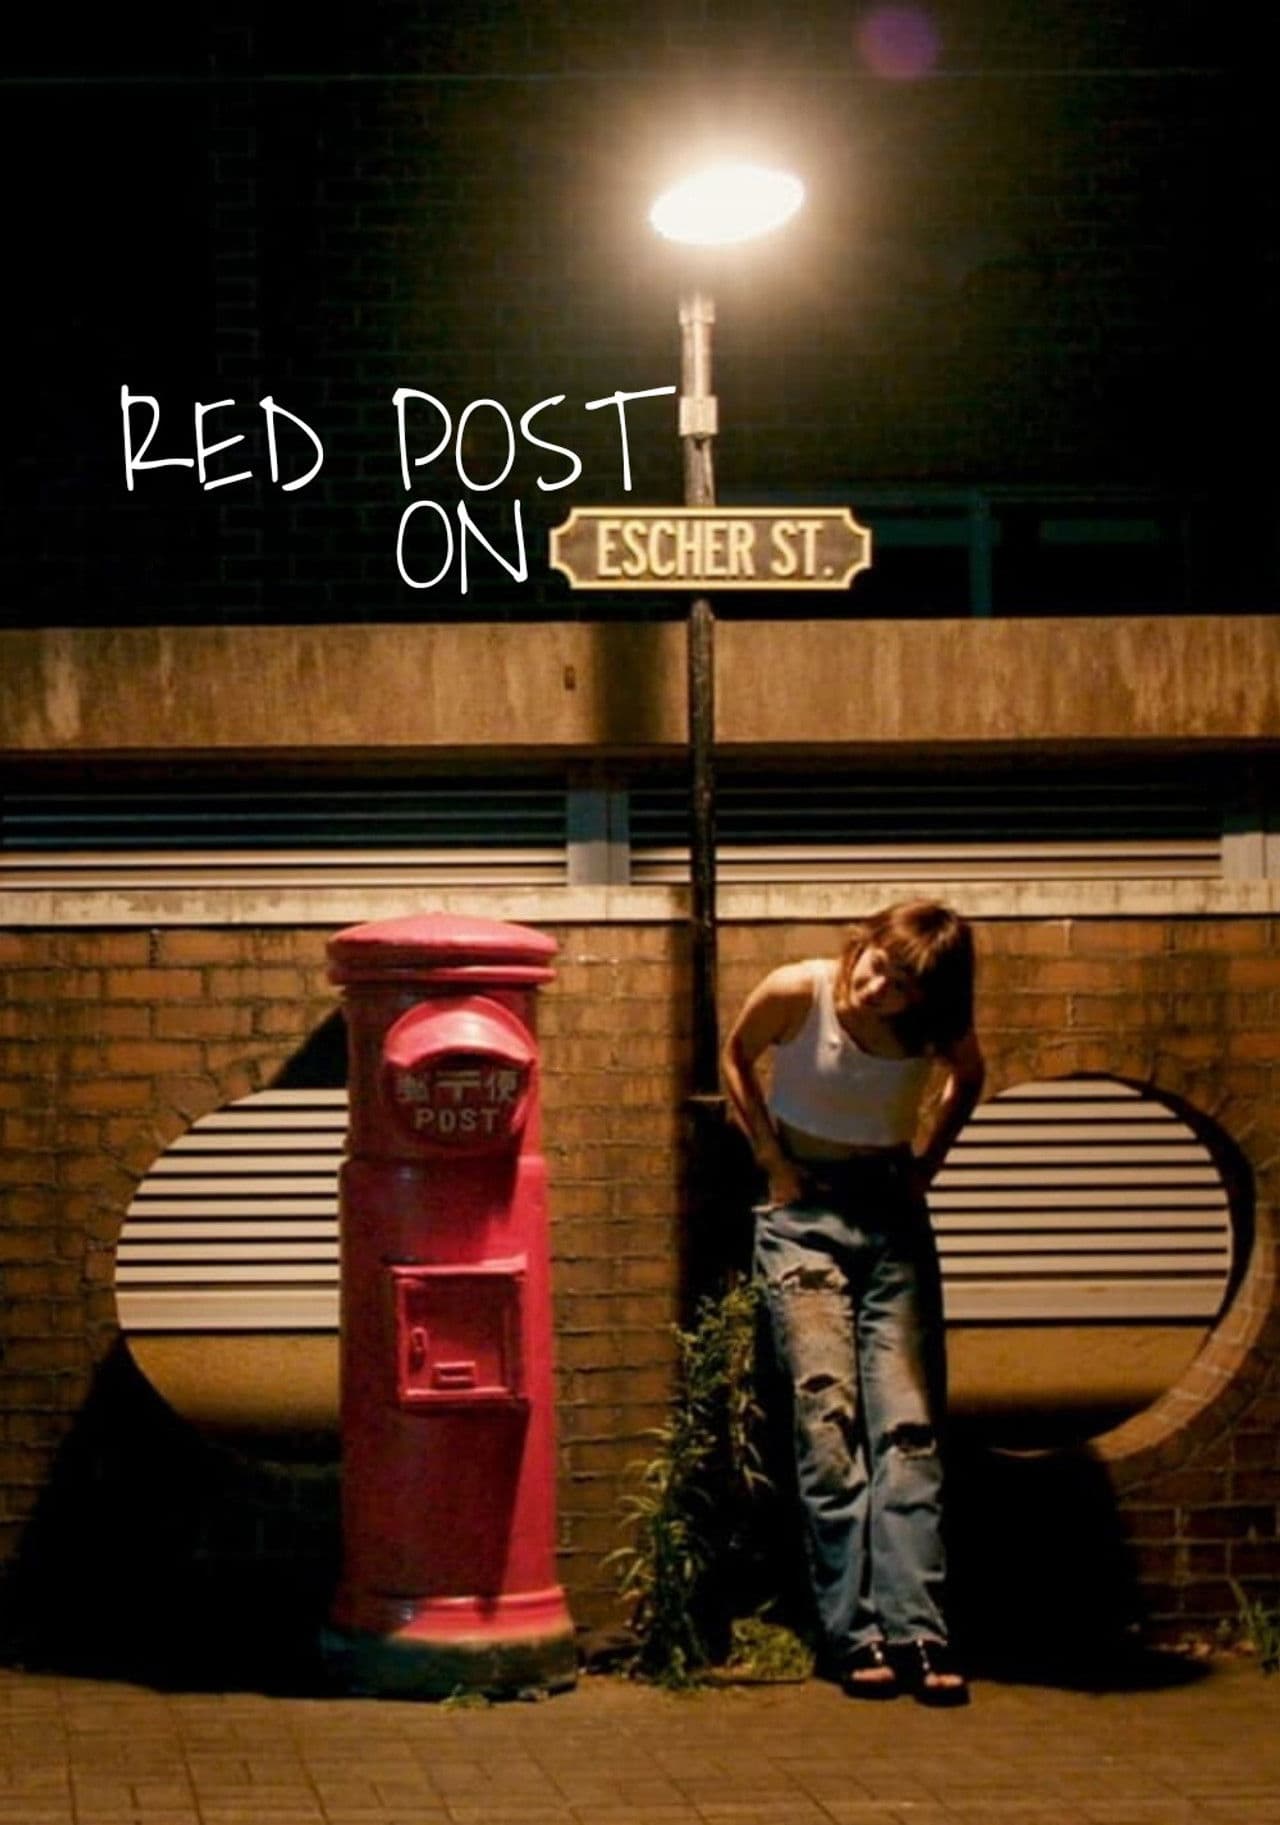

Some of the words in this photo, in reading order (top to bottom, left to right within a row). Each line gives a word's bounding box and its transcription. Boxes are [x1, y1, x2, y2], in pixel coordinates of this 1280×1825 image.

[595, 520, 756, 579] ESCHER
[770, 520, 834, 578] ST.
[414, 1107, 500, 1133] POST
